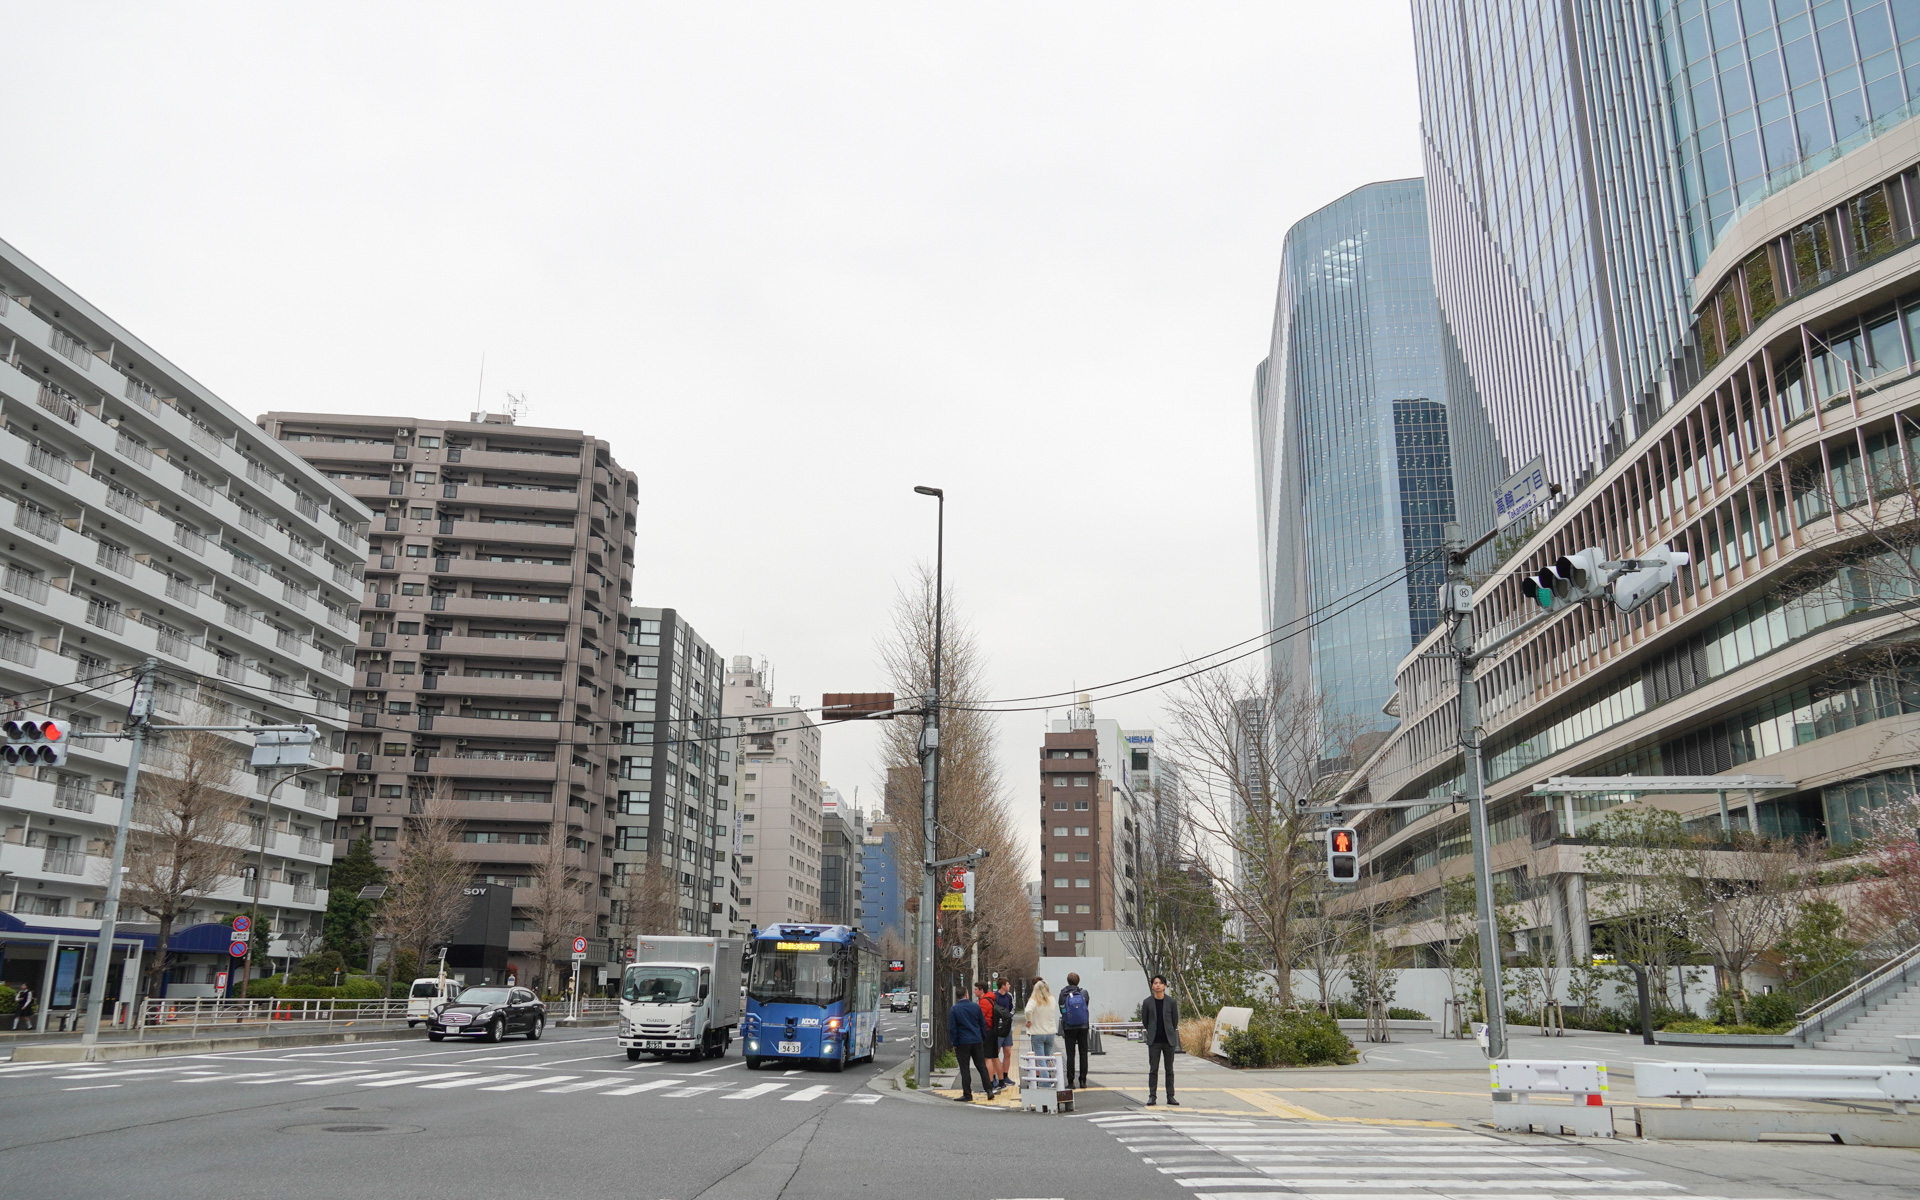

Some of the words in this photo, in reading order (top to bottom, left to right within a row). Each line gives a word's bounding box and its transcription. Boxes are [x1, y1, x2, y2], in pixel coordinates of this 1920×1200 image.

[1496, 469, 1543, 516] 高輪二丁目
[1507, 499, 1532, 520] Takanawa
[1532, 493, 1538, 504] 2
[463, 888, 487, 896] SOY
